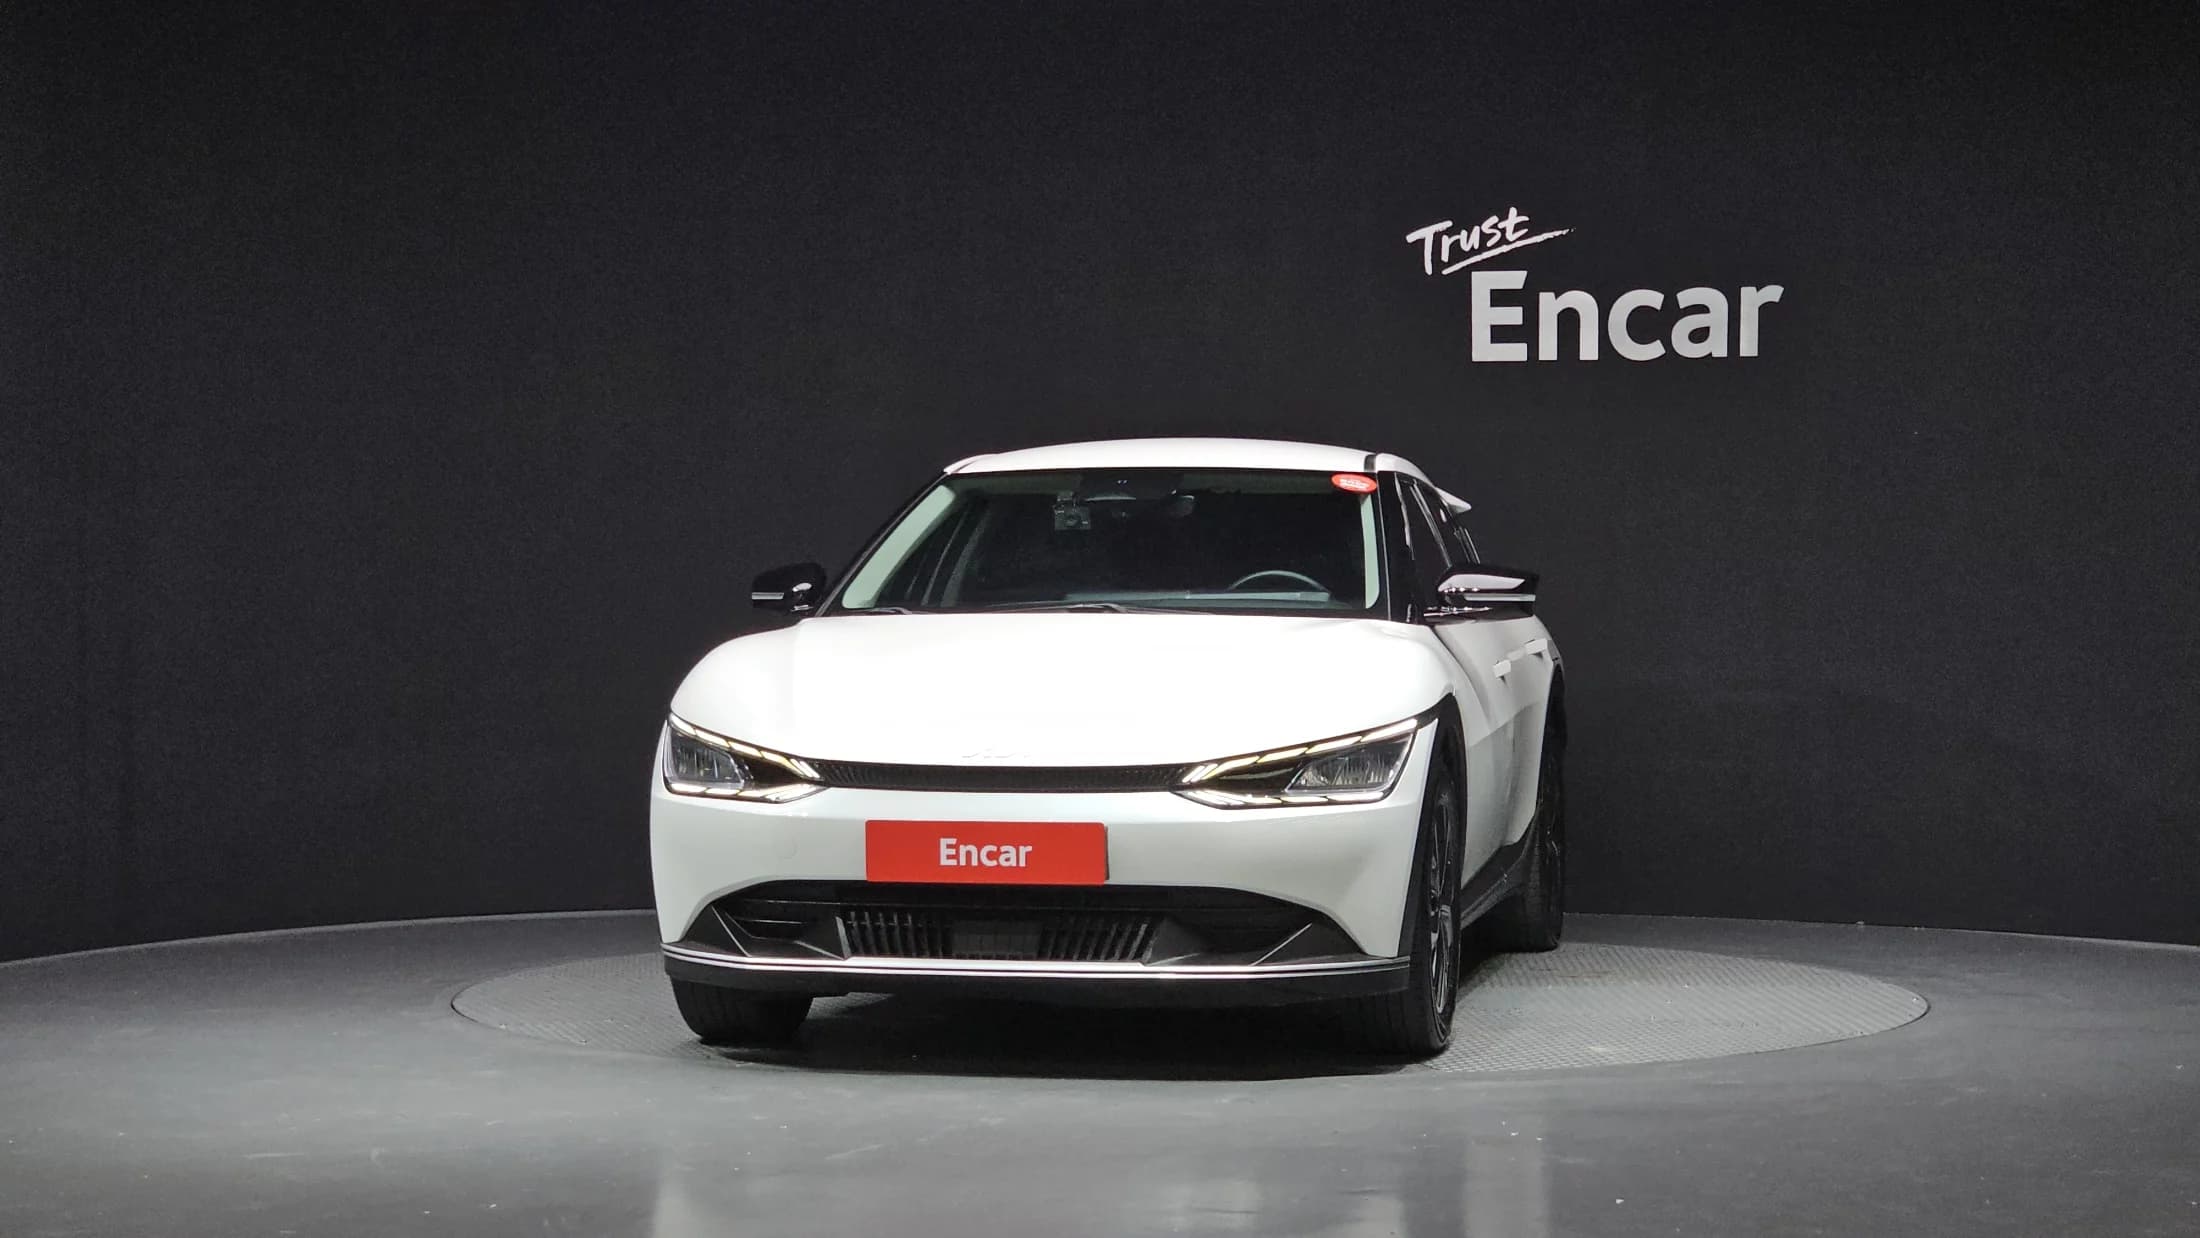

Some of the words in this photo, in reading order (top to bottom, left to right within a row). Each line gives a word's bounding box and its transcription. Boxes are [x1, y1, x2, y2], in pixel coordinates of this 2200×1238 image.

[1406, 206, 1529, 275] Trust
[1471, 270, 1785, 362] Encar
[938, 837, 1033, 868] Encar
